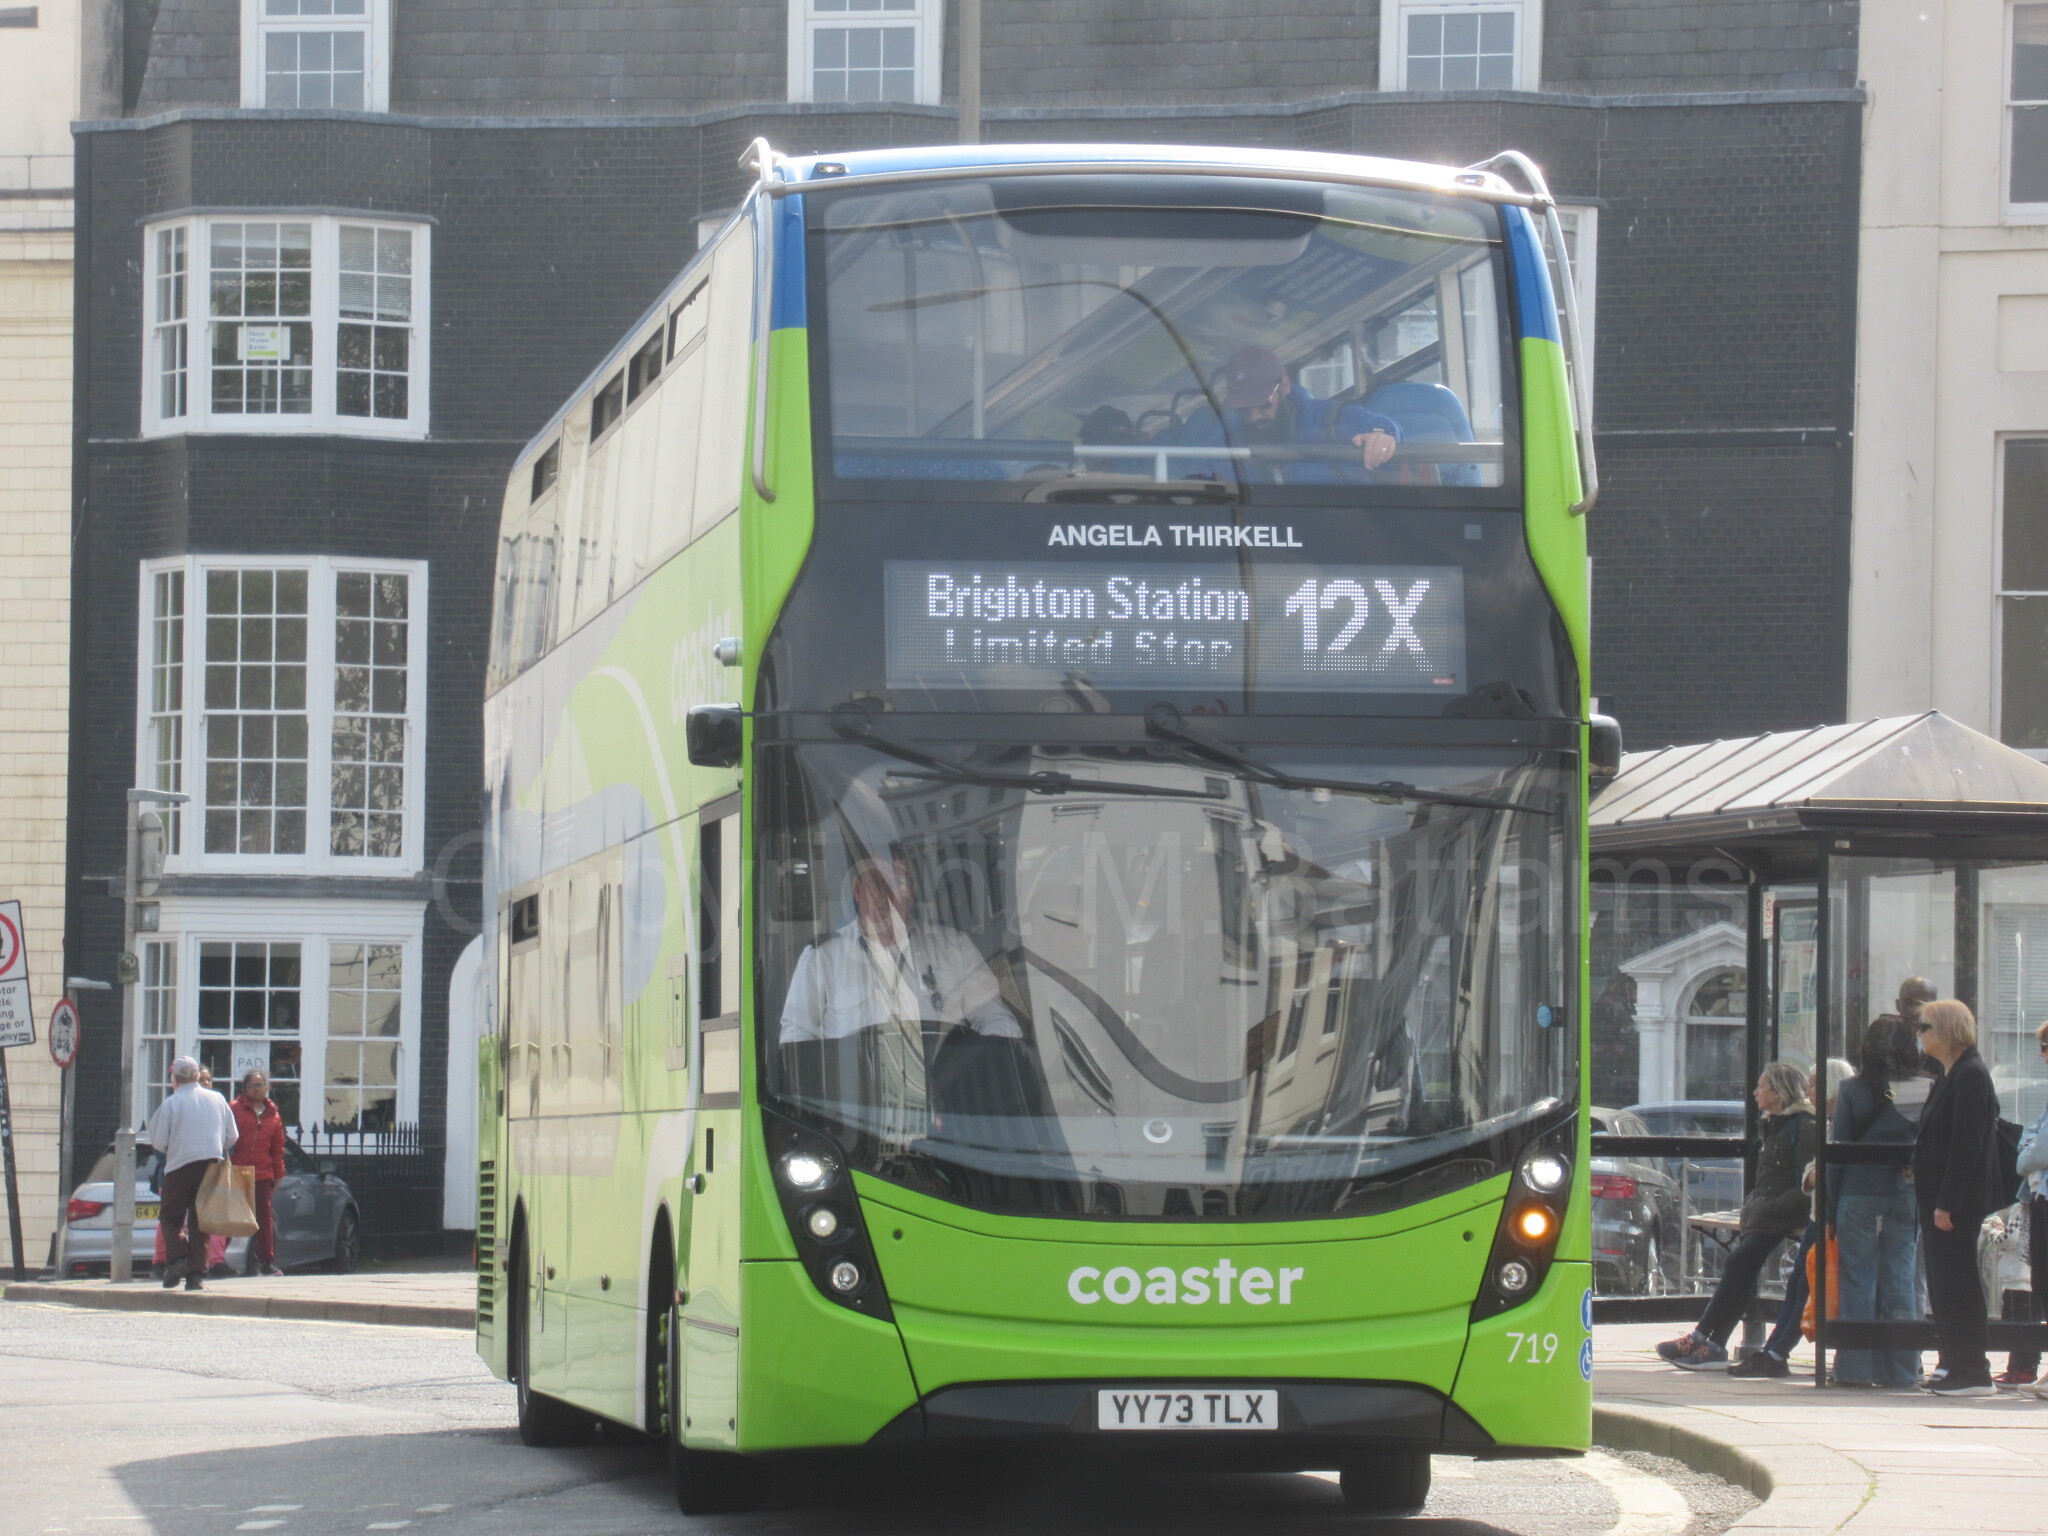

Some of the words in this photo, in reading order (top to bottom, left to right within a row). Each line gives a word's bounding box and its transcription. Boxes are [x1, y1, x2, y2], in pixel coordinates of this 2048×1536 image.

[1048, 524, 1162, 548] ANGELA
[1170, 525, 1303, 549] THIRKELL
[927, 573, 1096, 622] Brighton
[1107, 575, 1250, 621] Station
[1284, 578, 1434, 673] 12X
[944, 628, 1113, 665] Limited
[1134, 629, 1233, 670] Stop
[237, 1057, 264, 1069] PAD
[1067, 1258, 1305, 1306] coaster
[1505, 1331, 1559, 1364] 719
[1112, 1394, 1194, 1424] YY73
[1203, 1394, 1264, 1424] TLX
